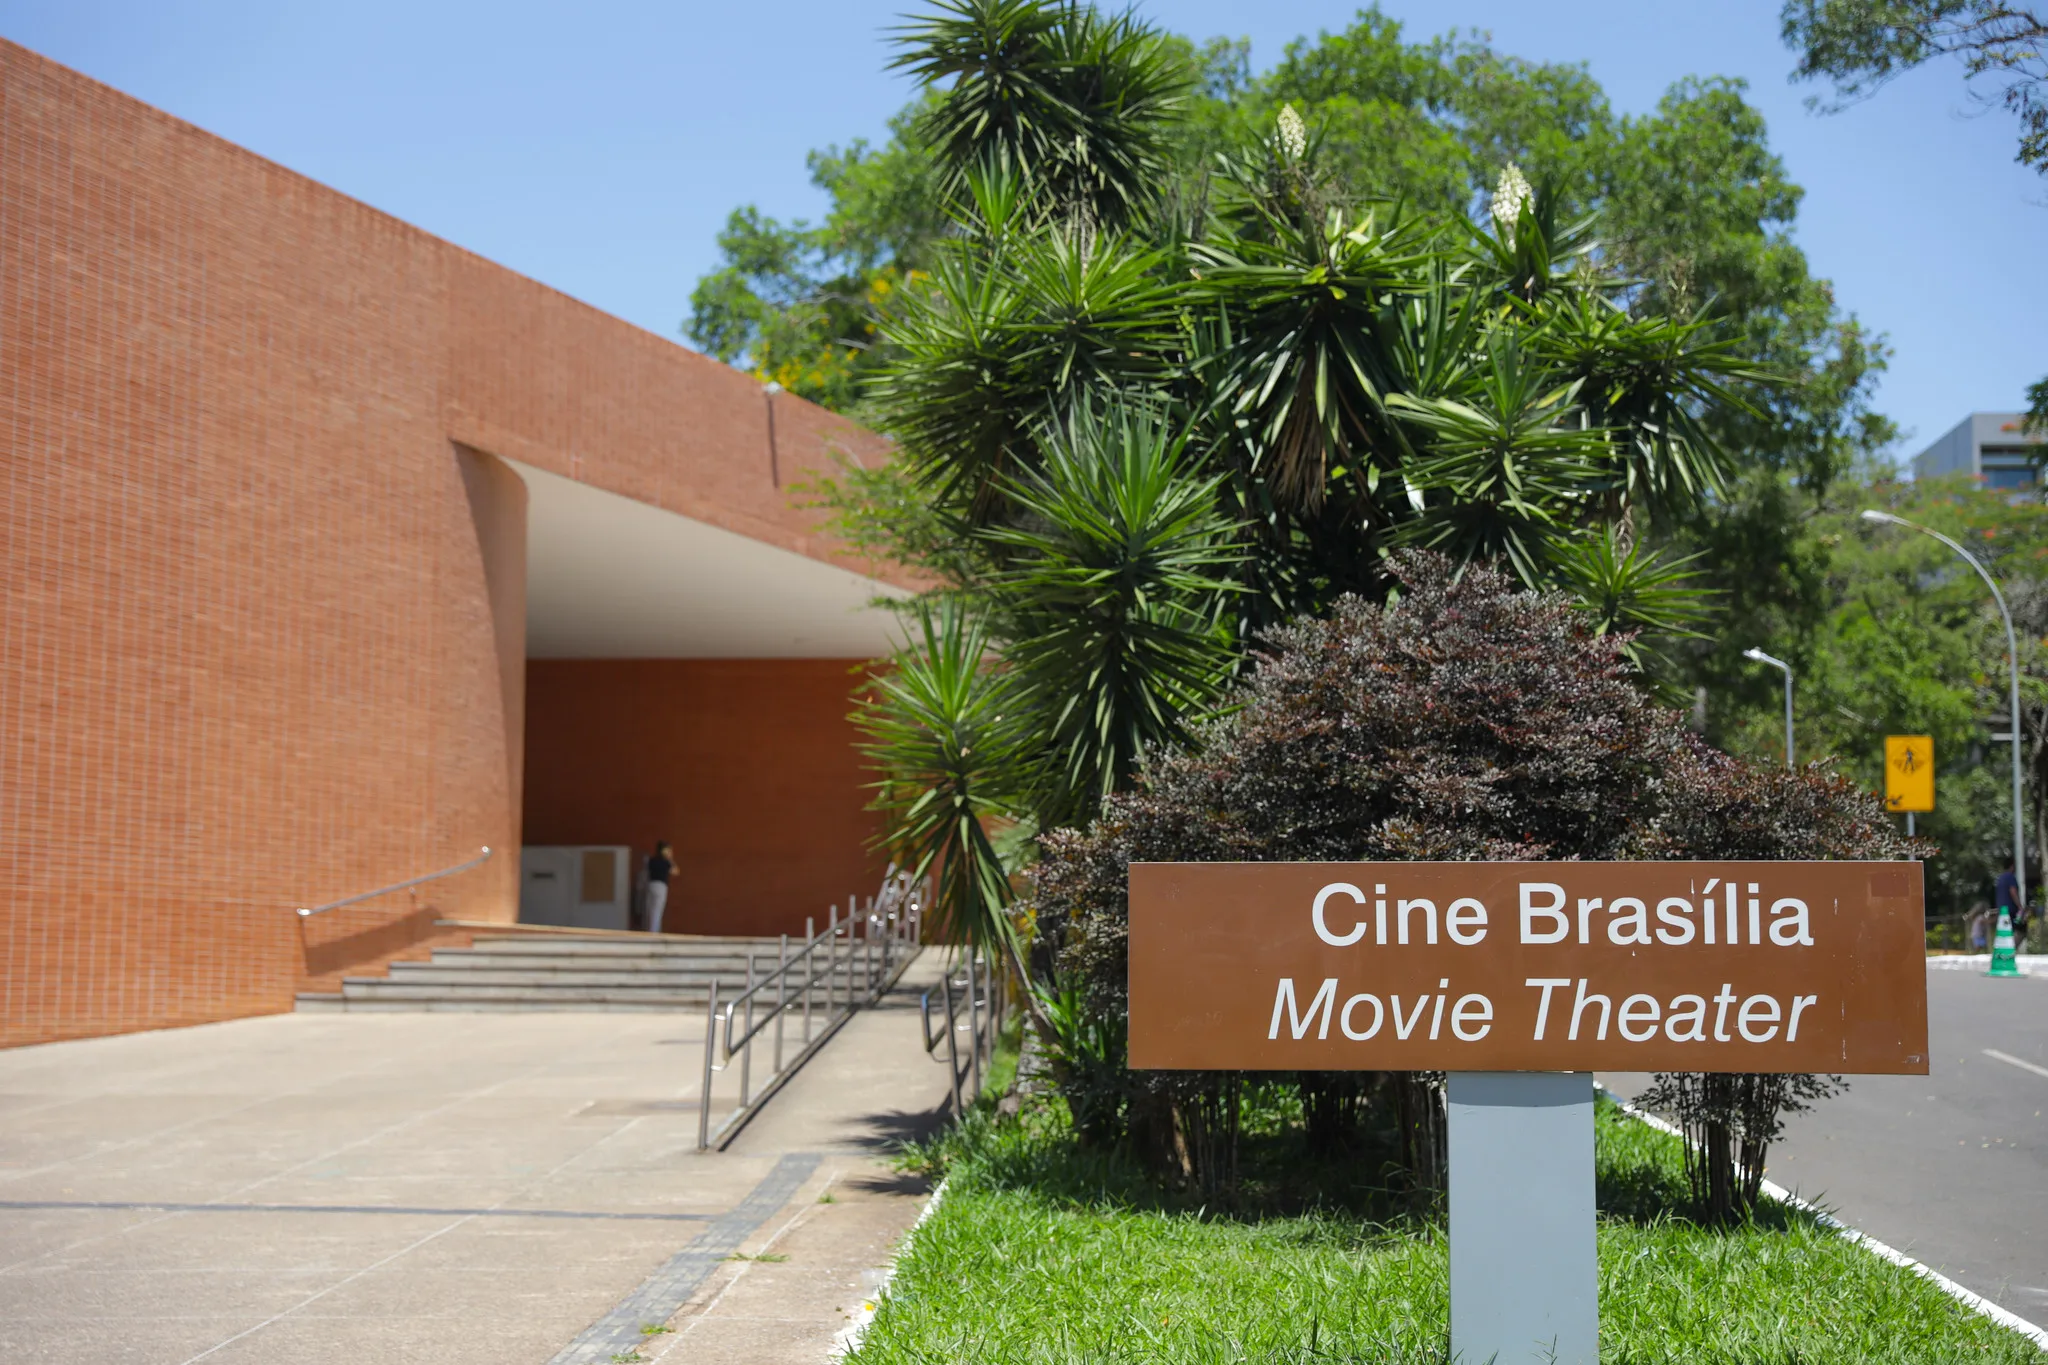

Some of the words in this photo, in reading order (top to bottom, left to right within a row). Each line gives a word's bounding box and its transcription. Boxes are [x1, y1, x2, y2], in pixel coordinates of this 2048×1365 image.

[1312, 882, 1488, 947] Cine
[1519, 878, 1814, 947] Brasília
[1268, 978, 1494, 1042] Movie
[1525, 978, 1817, 1043] Theater
